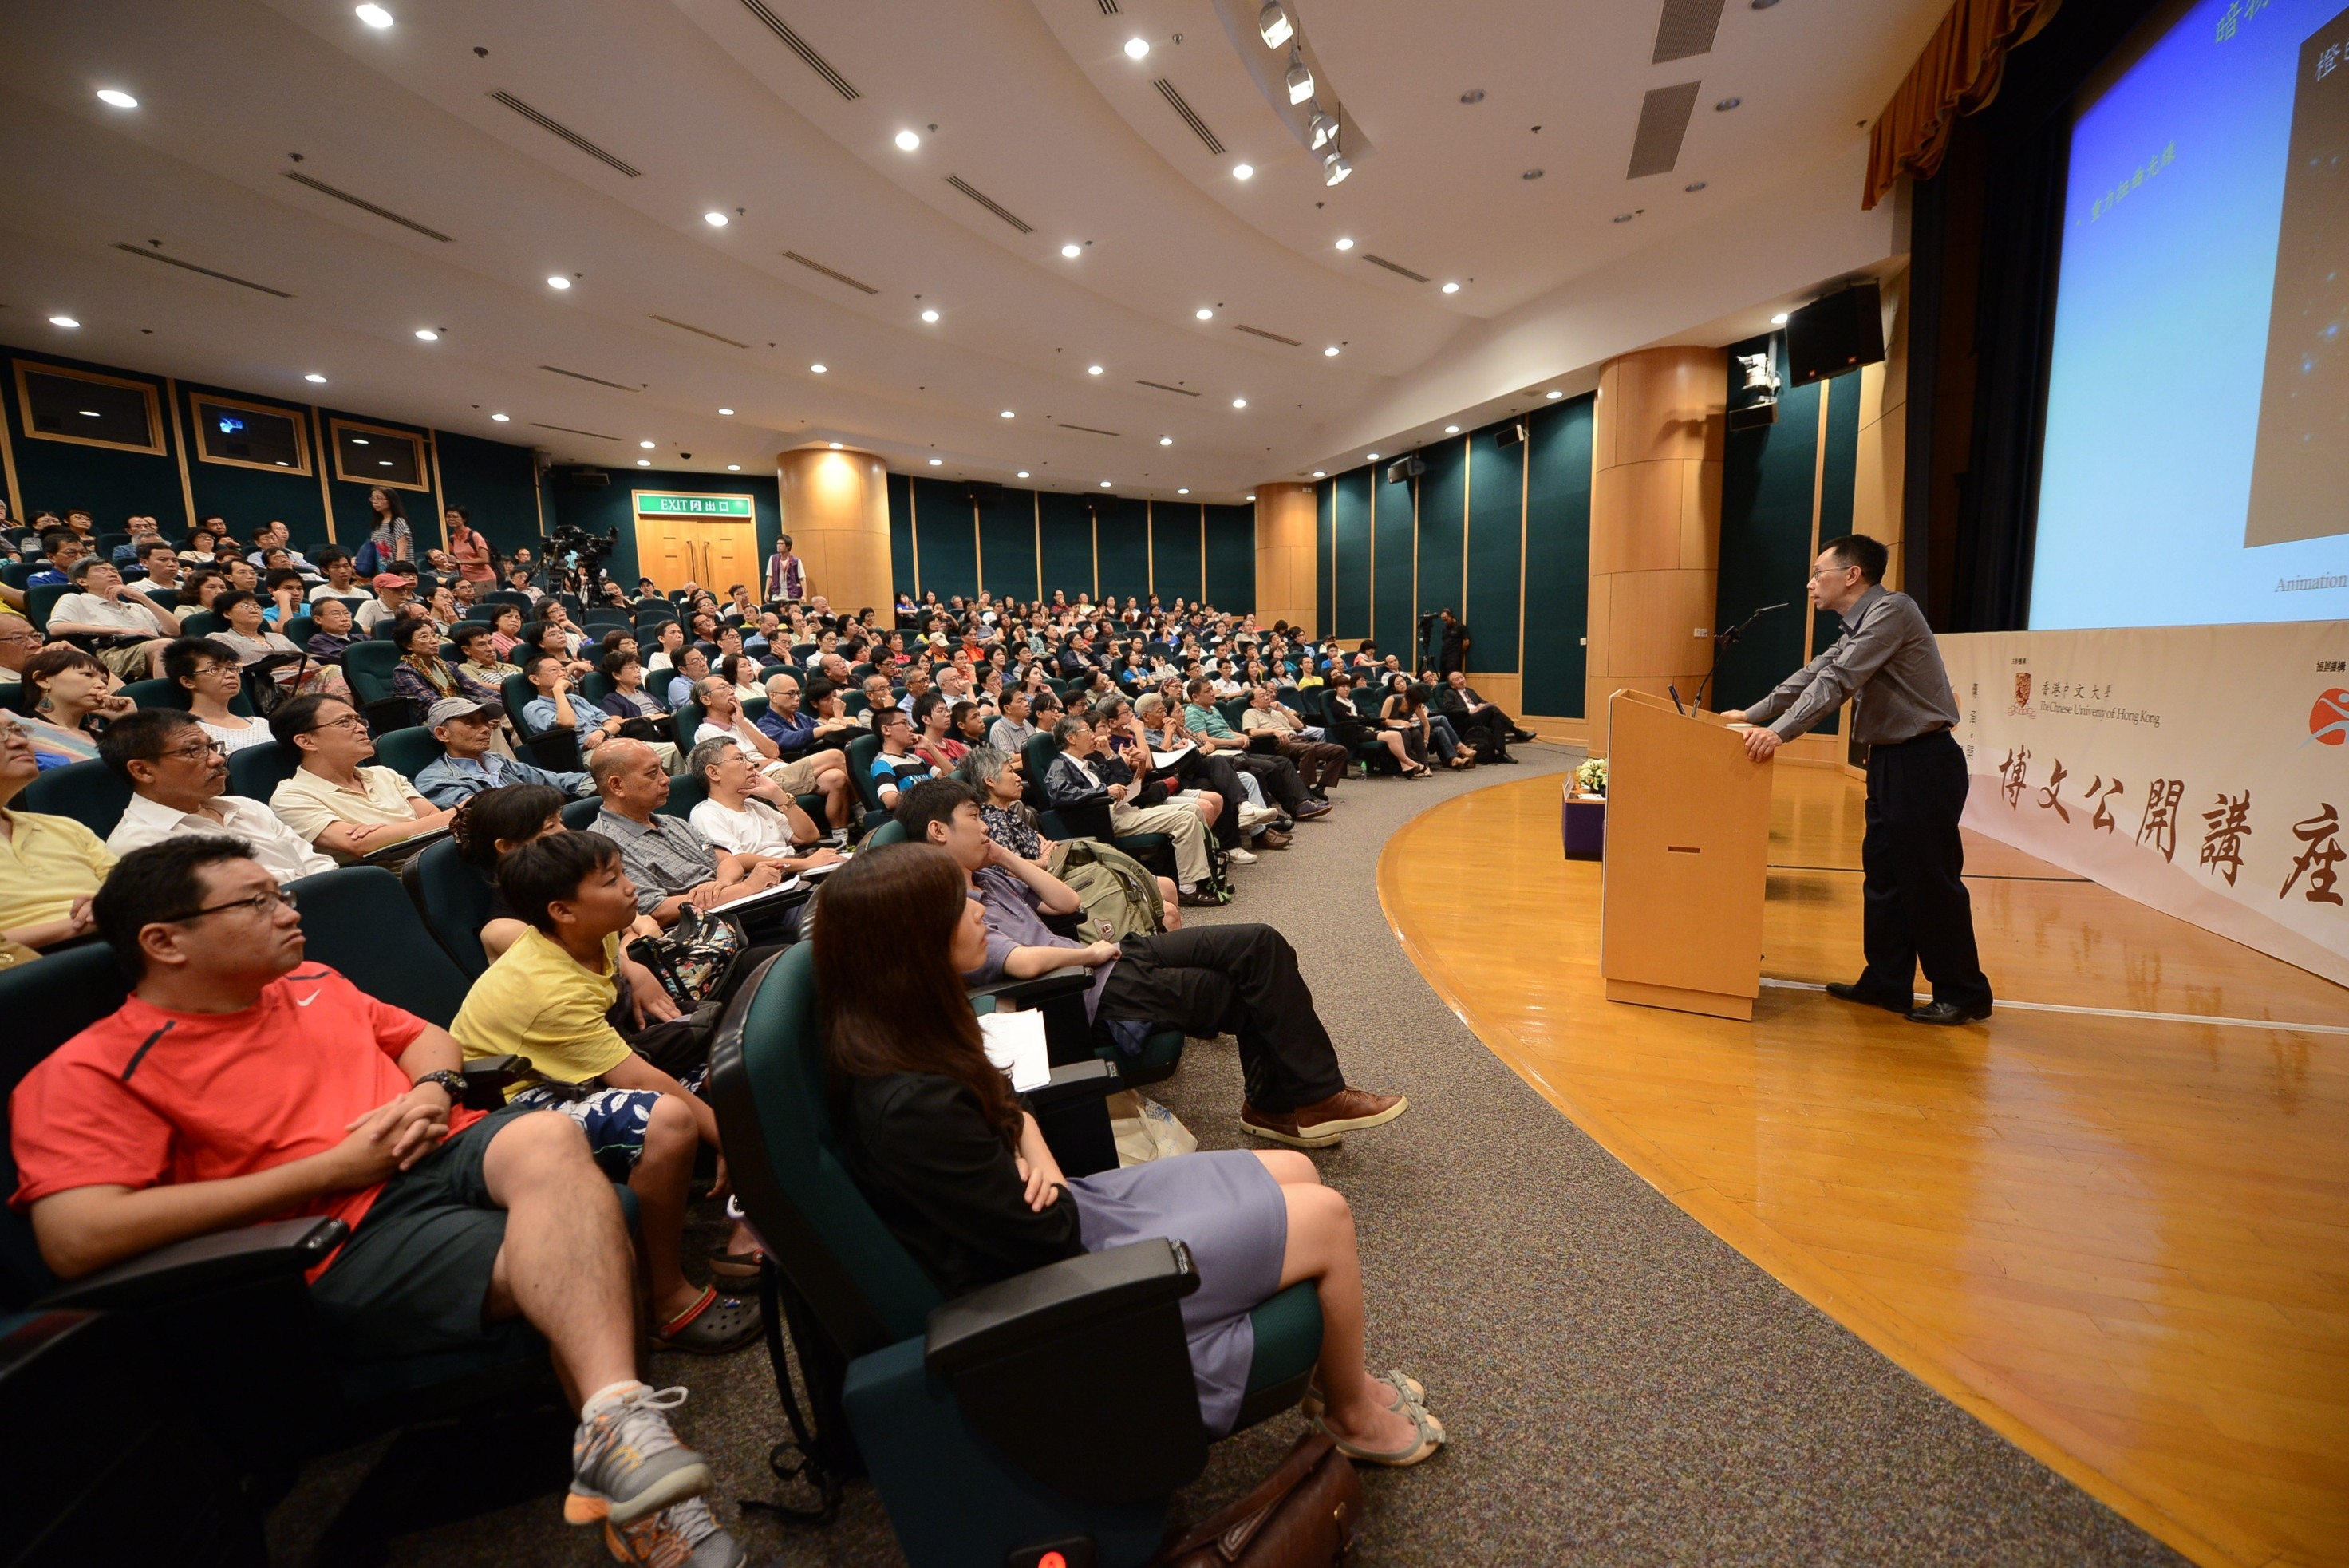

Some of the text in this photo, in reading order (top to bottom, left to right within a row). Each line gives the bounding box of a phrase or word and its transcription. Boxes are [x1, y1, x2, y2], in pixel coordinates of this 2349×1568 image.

[660, 498, 729, 512] EXIT 出口
[2274, 571, 2348, 593] Animation
[2040, 700, 2050, 712] The
[2106, 708, 2116, 719] of
[2116, 708, 2139, 725] Hong
[2139, 709, 2161, 728] Kong
[1998, 744, 2347, 906] 博文公開講座
